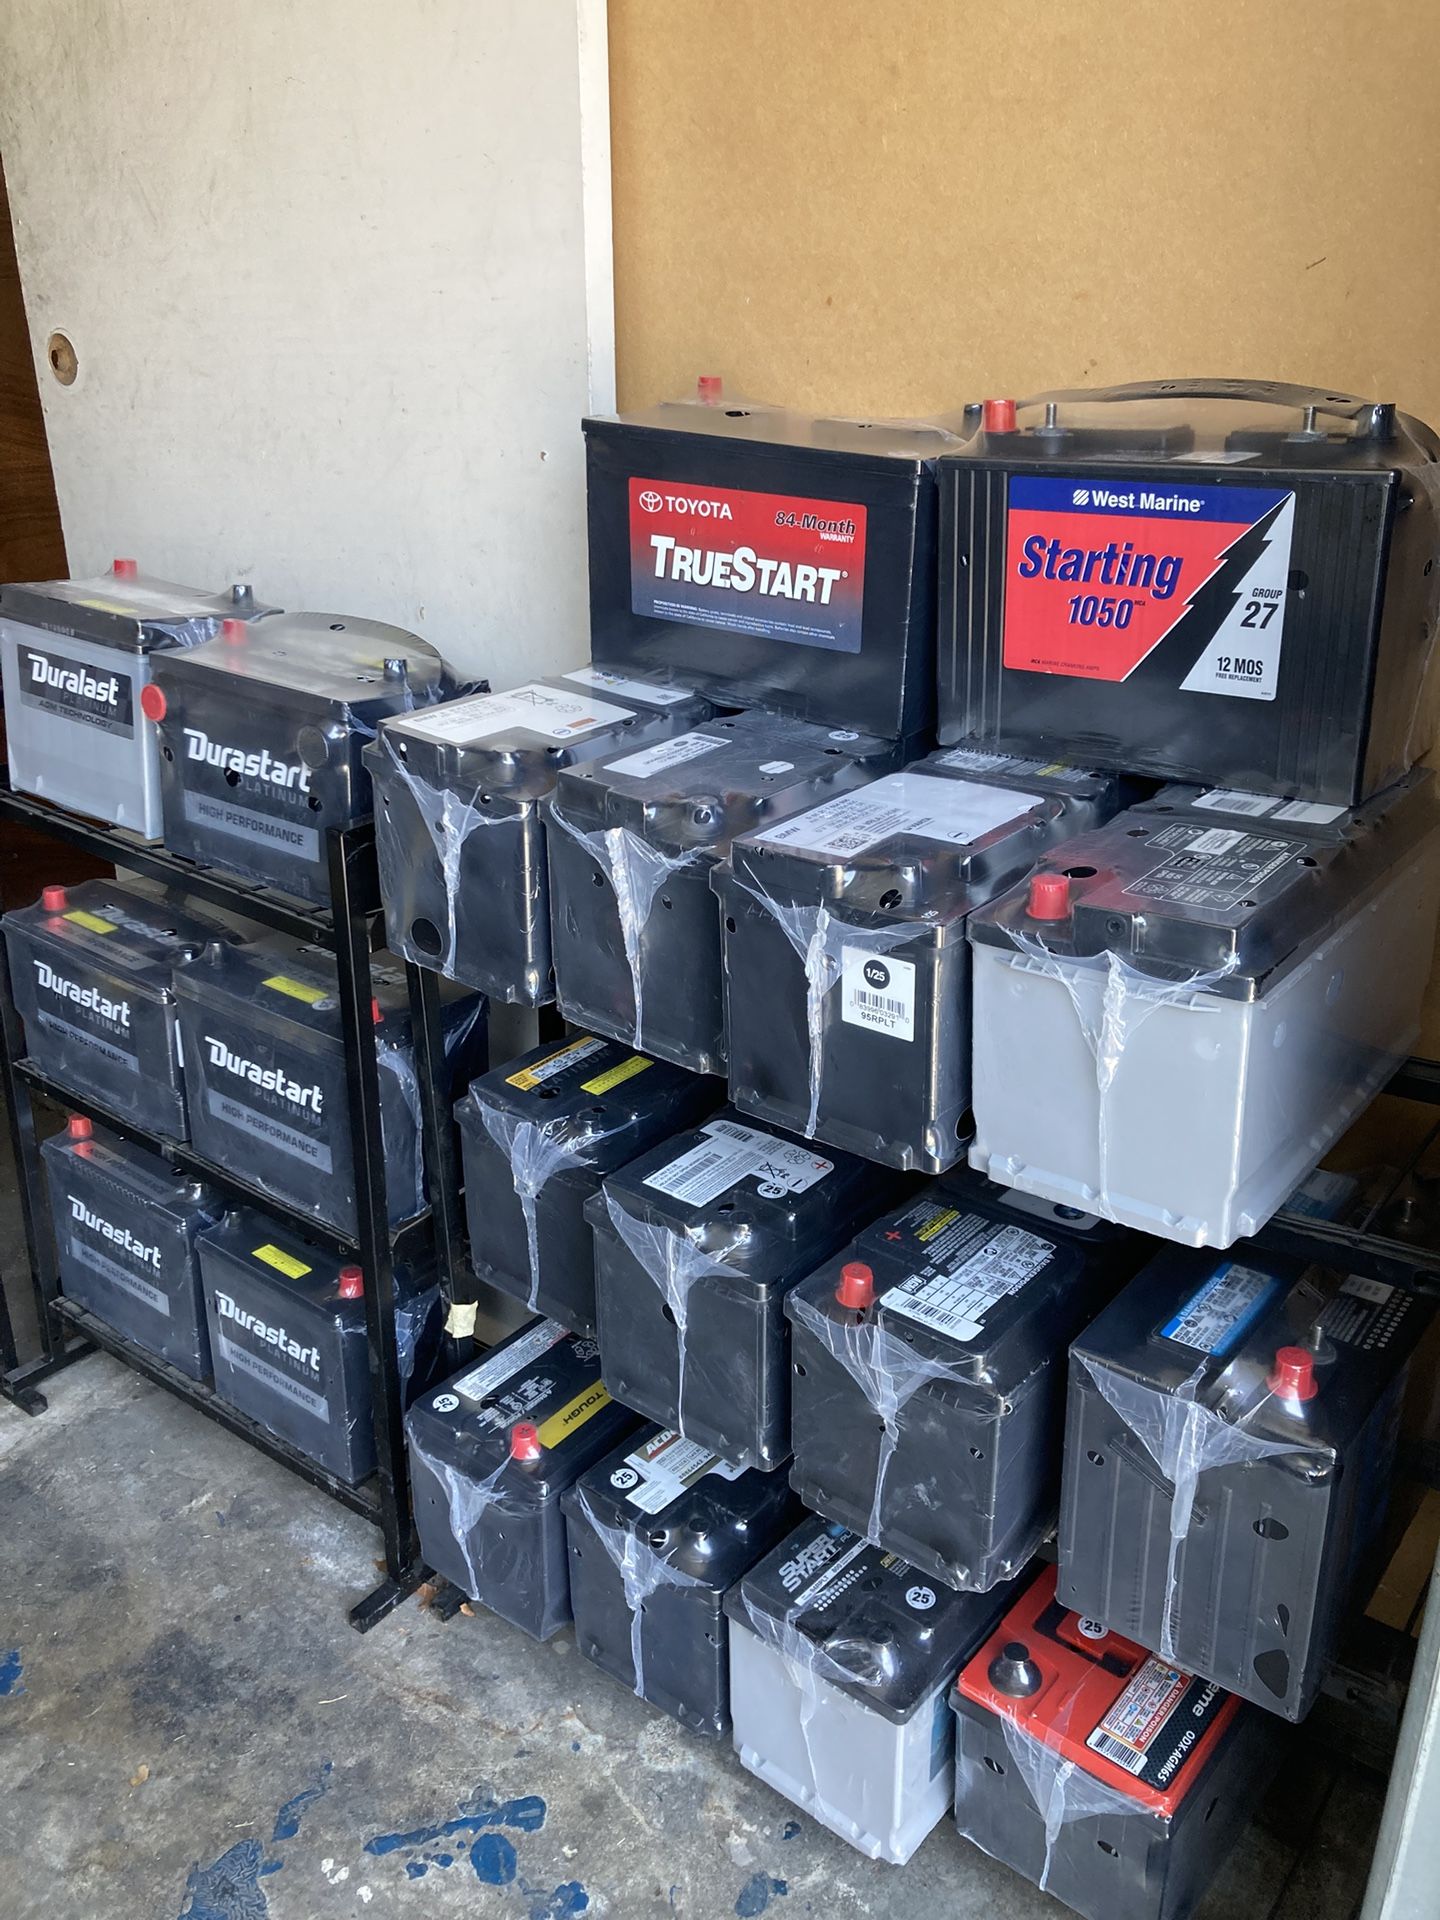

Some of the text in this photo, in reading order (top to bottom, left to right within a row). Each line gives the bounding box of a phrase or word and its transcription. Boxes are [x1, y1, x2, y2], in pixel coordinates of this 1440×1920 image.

[665, 495, 733, 521] TOYOTA
[1091, 490, 1201, 512] West Marine
[775, 511, 856, 534] 84-Month
[820, 533, 854, 543] WARRANTY
[1017, 535, 1184, 599] Starting
[1252, 588, 1283, 599] GROUP
[1068, 594, 1134, 630] 1050
[1240, 601, 1279, 629] 27
[28, 653, 119, 705] Duralast
[1216, 672, 1262, 683] FREE REPLACEMENT
[1217, 656, 1263, 676] 12 MOS
[38, 700, 113, 729] AGM TECHNOLOGY
[183, 727, 312, 793] Durastart
[199, 803, 304, 846] HIGH PERFORMANCE
[866, 967, 885, 982] 1/25
[33, 959, 130, 1027] Durastart
[861, 1012, 896, 1028] 95RPLT
[204, 1035, 323, 1113] Durastart
[255, 1086, 321, 1127] PLATINUM
[222, 1101, 318, 1158] HIGH PERFORMANCE
[764, 1184, 781, 1195] 25
[67, 1194, 162, 1269] Durastart
[101, 1260, 159, 1303] PERFORMANCE
[214, 1289, 320, 1371] Durastart
[230, 1347, 317, 1408] HIGH PERFORMANCE
[260, 1340, 319, 1382] PLATINUM
[438, 1397, 453, 1408] 25
[563, 1391, 603, 1424] TOUGH
[616, 1473, 633, 1484] 25
[778, 1533, 832, 1577] SUPER
[782, 1545, 841, 1592] START
[912, 1591, 930, 1604] 25
[1084, 1620, 1102, 1633] 25
[1139, 1682, 1184, 1743] DANGER/POISON
[1157, 1730, 1196, 1782] ODX-AGM65
